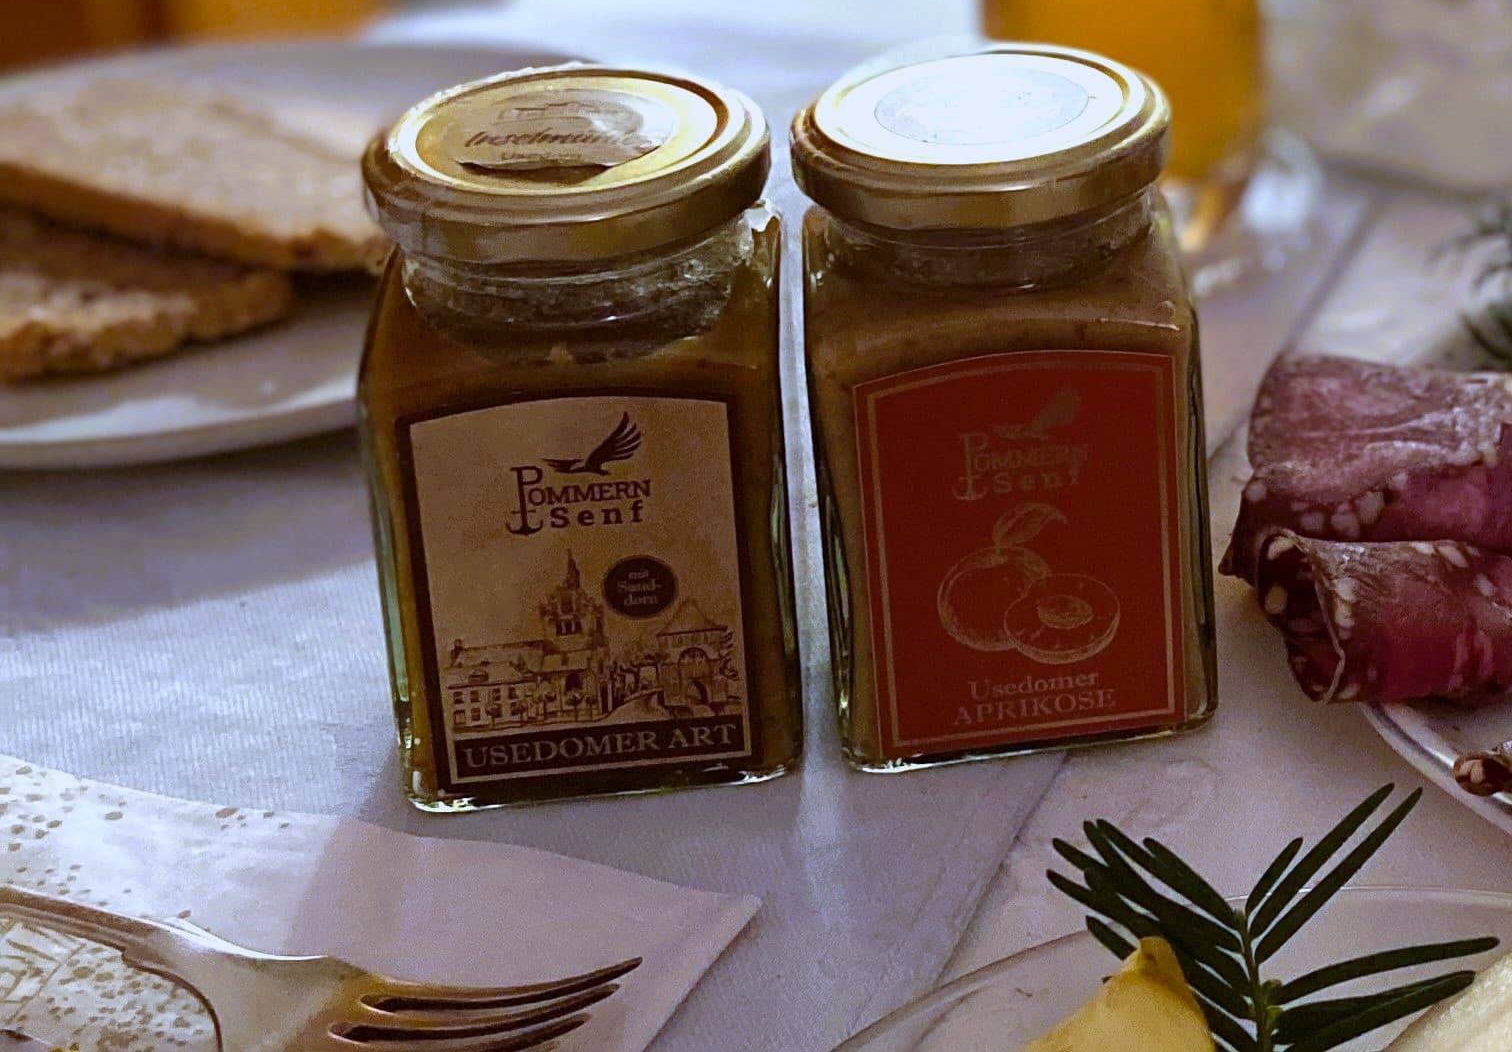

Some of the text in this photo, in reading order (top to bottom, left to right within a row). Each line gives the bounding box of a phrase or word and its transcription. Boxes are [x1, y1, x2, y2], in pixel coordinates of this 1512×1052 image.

[993, 467, 1080, 493] Senf
[506, 465, 651, 536] POMMERN
[550, 500, 644, 528] Senf
[968, 671, 1100, 701] Usedomer
[953, 688, 1117, 726] APRIKOSE
[465, 721, 738, 770] USEDOMER ART
